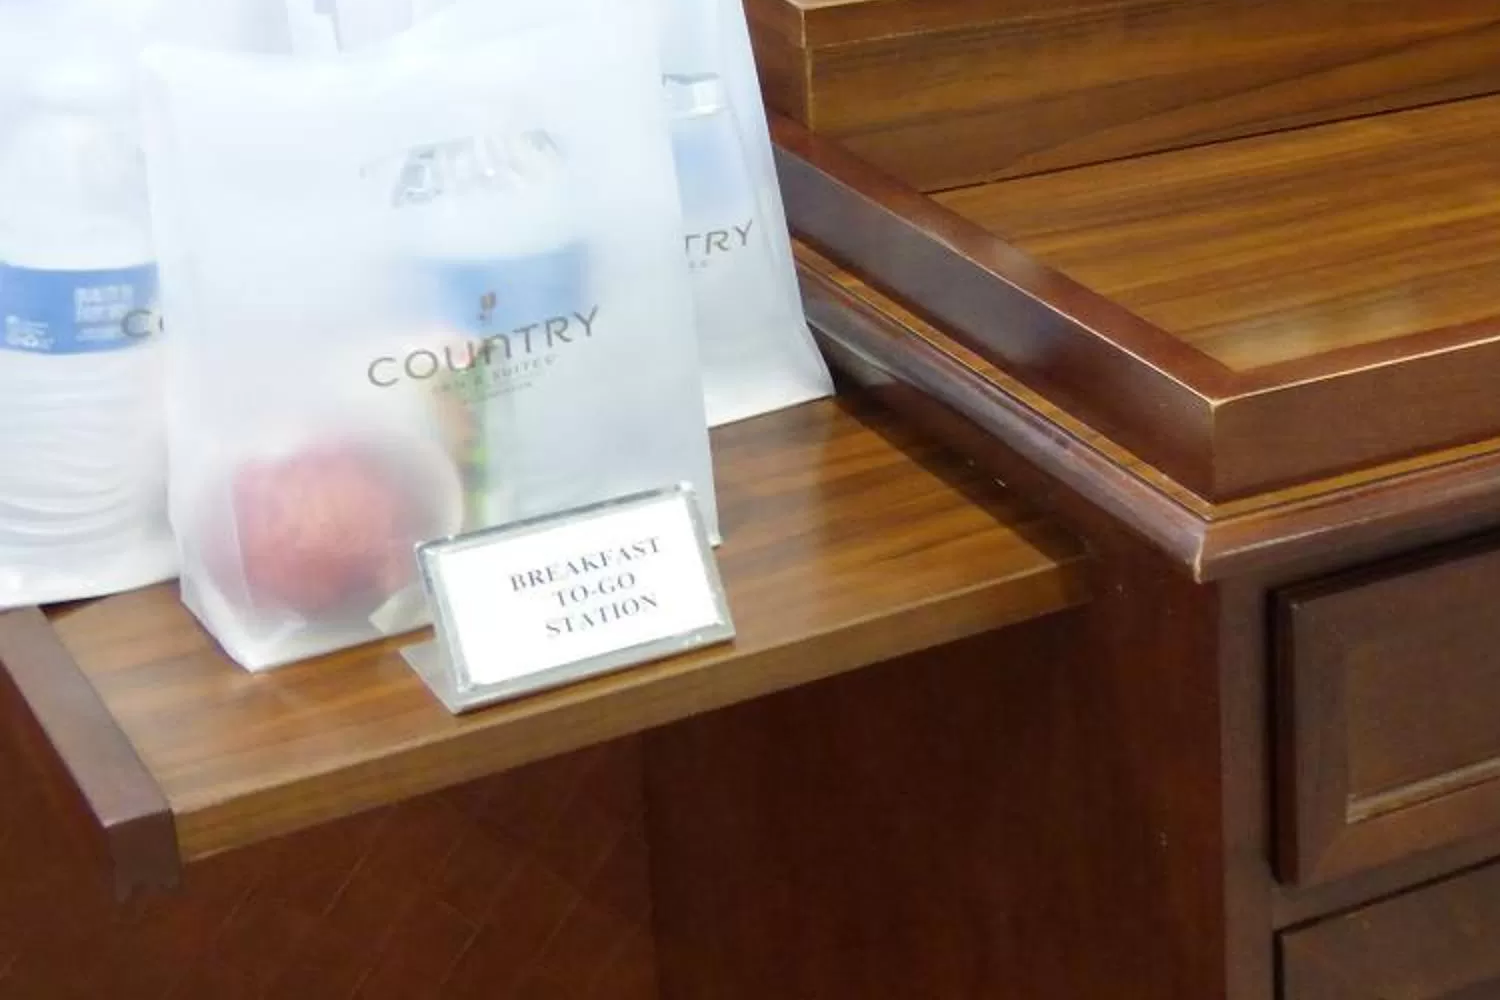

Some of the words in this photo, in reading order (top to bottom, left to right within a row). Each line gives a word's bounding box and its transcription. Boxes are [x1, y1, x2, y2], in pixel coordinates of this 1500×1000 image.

[367, 305, 601, 388] COUNTRY
[509, 536, 662, 593] BREAKFAST
[552, 571, 636, 608] TO-GO
[545, 592, 658, 637] STATION
